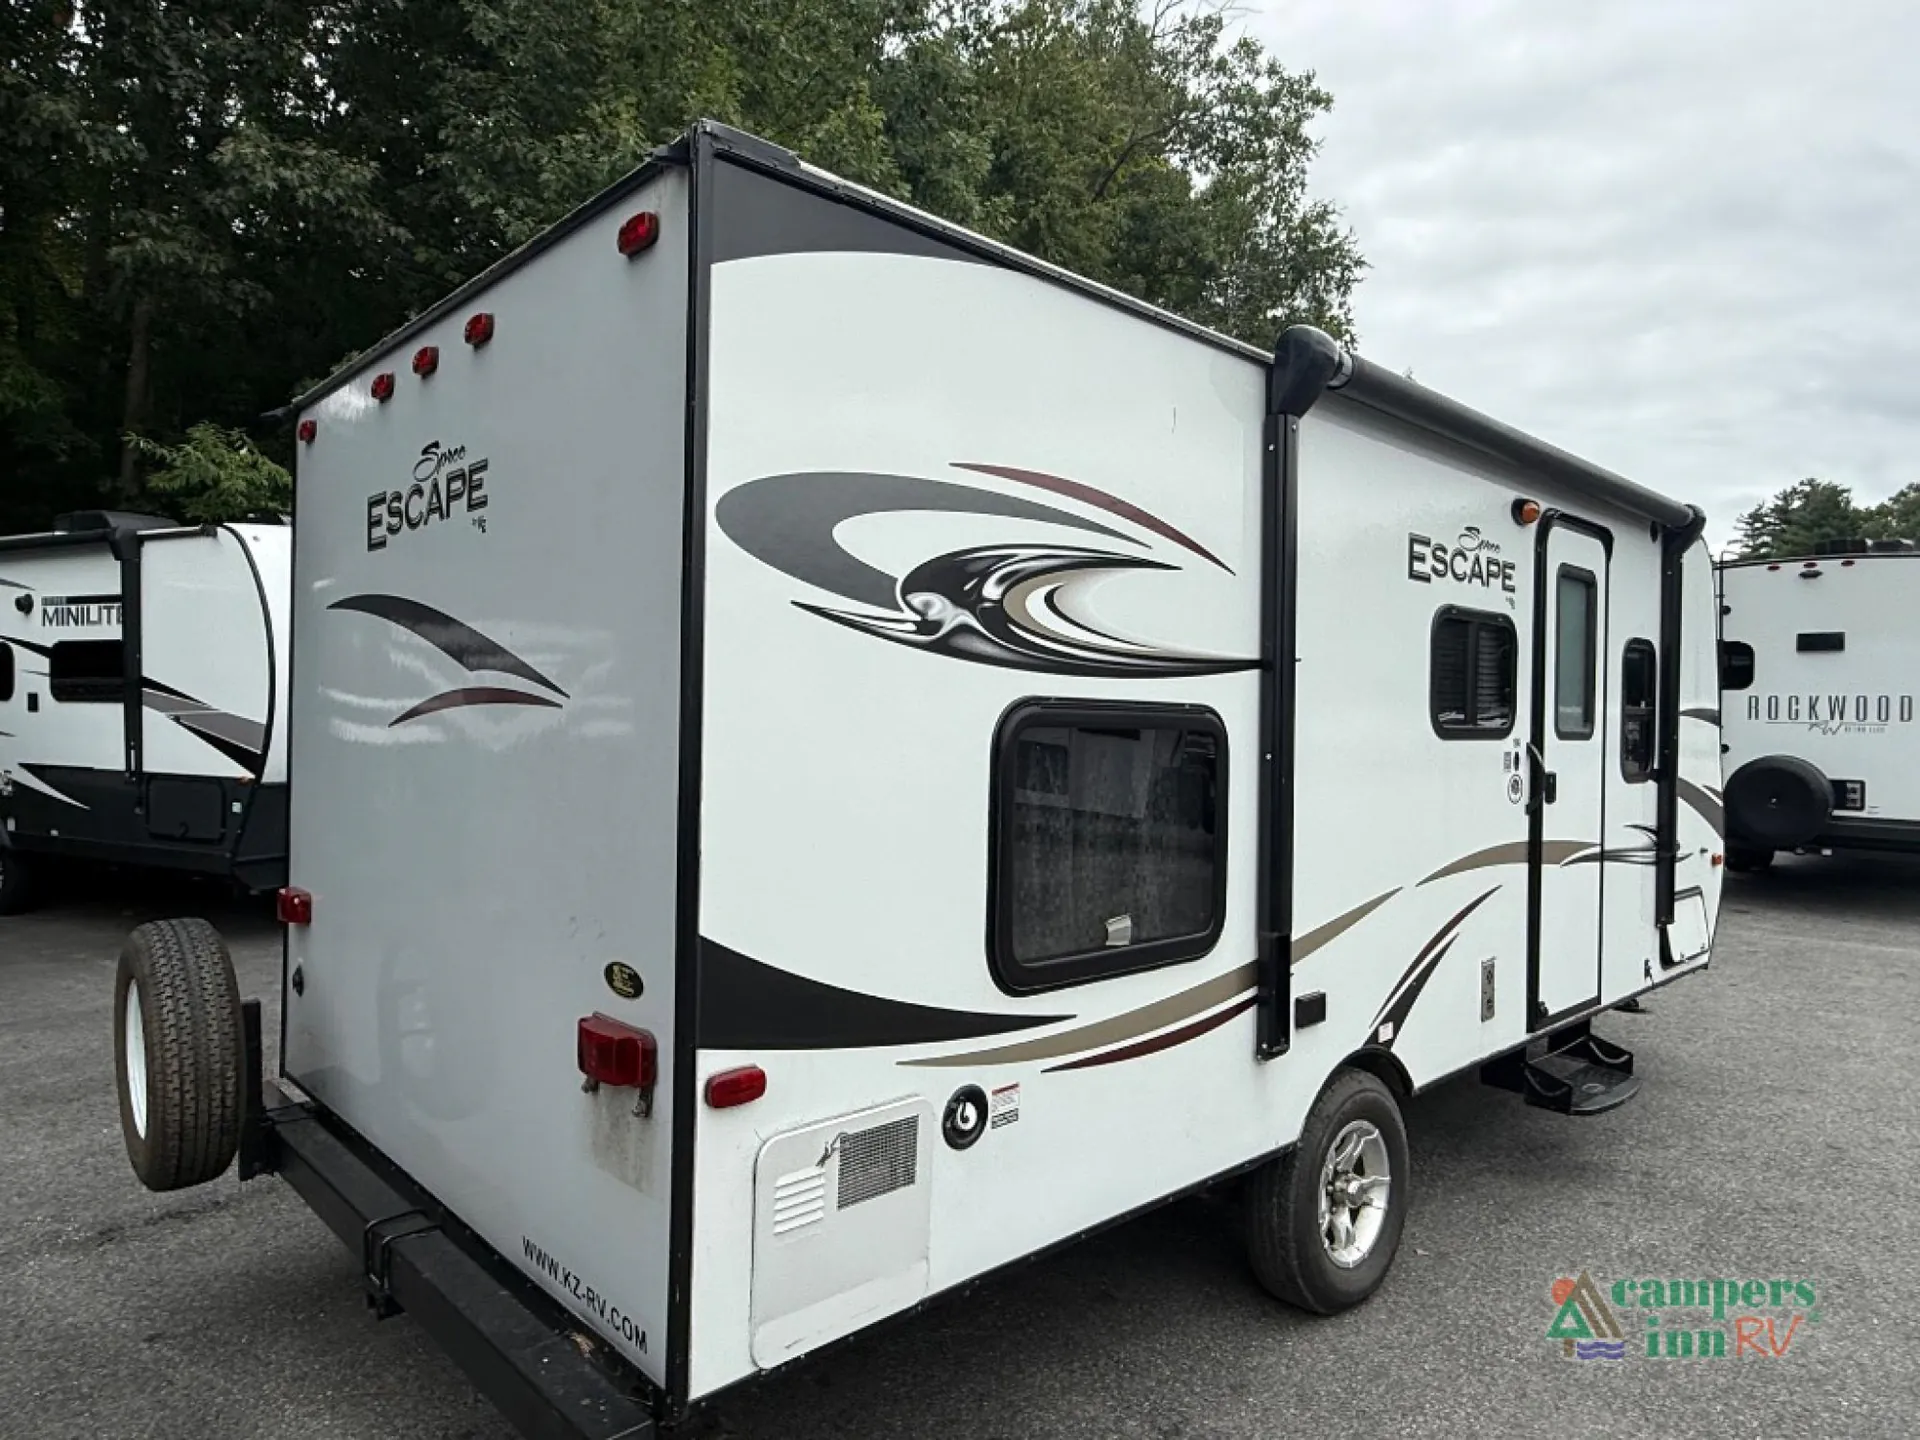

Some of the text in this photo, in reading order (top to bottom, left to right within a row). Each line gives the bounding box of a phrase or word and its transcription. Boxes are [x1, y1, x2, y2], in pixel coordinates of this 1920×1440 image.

[367, 457, 489, 553] ESCAPE
[1408, 532, 1516, 593] ESCAPE
[1747, 695, 1914, 722] ROCKWOOD
[522, 1235, 648, 1354] WWW.KZ-RV.COM
